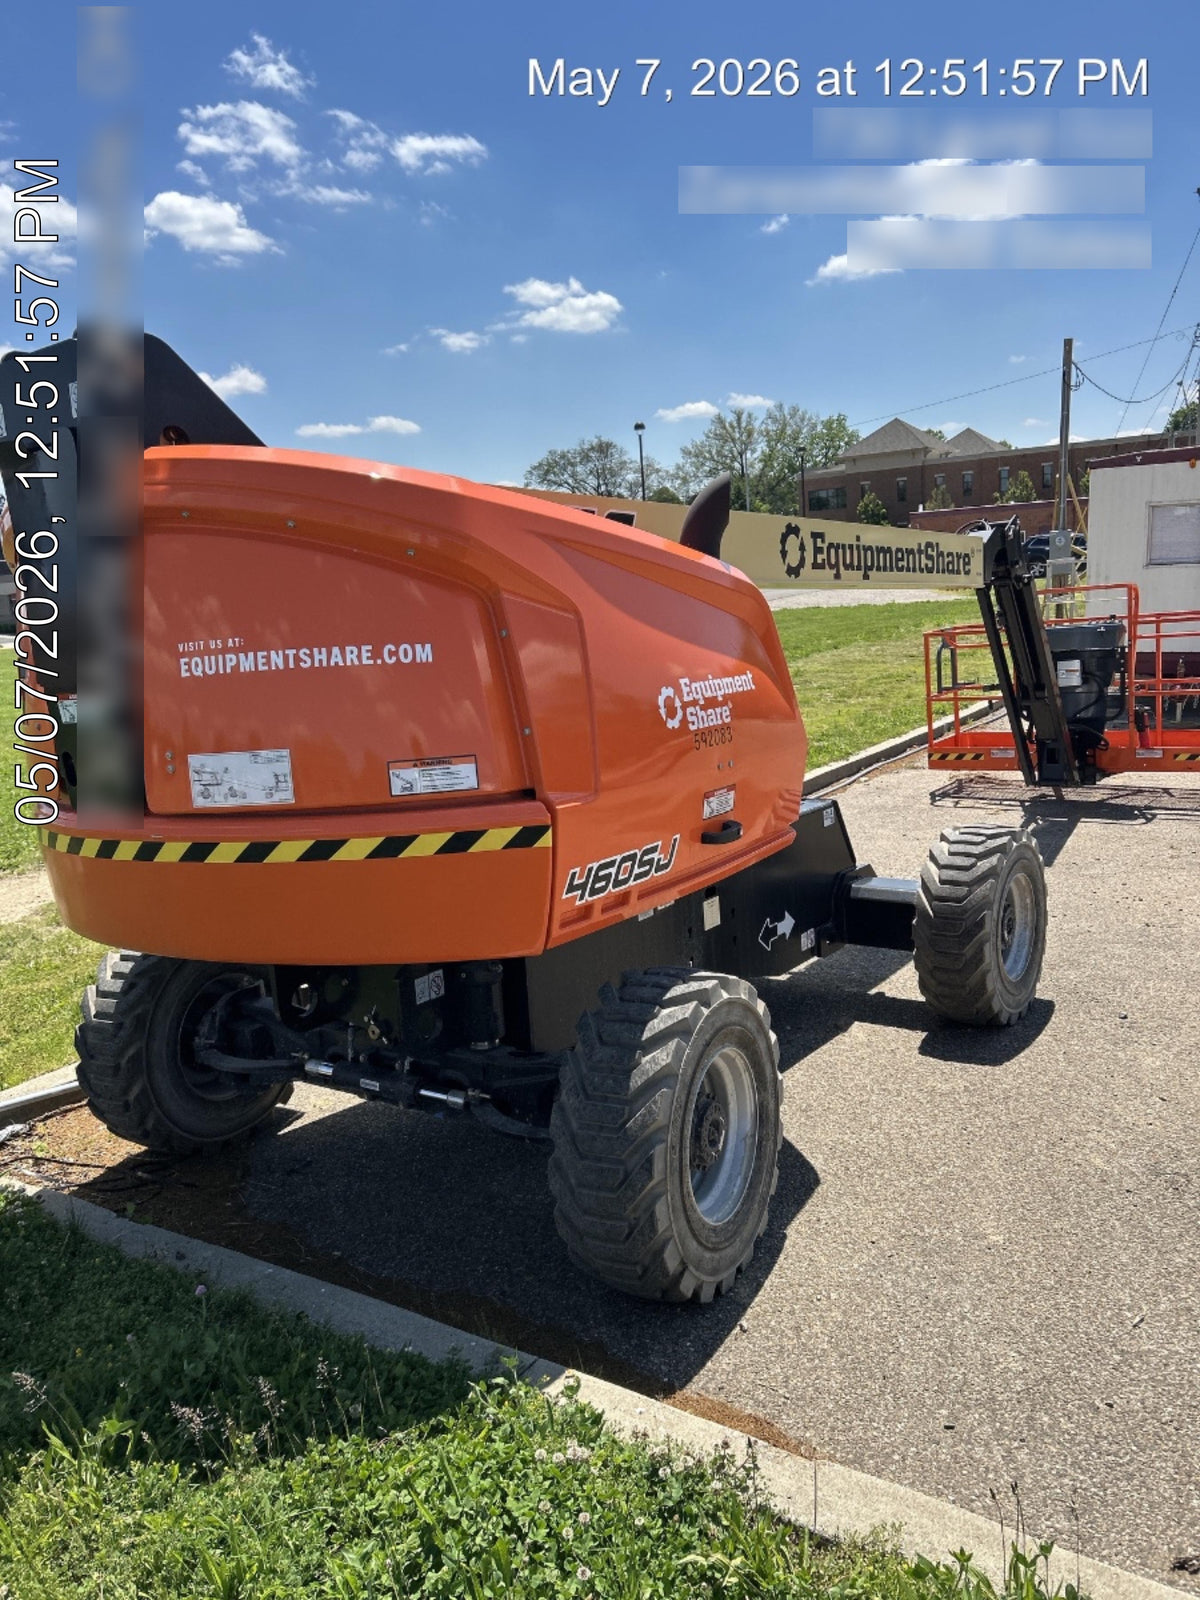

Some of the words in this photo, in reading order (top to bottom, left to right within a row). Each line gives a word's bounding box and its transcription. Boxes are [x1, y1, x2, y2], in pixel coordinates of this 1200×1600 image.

[811, 531, 972, 580] EquipmentShare
[178, 641, 205, 653] VISIT
[209, 640, 223, 649] US
[227, 638, 244, 648] AT:
[179, 643, 433, 678] EQUIPMENTSHARE.COM
[679, 670, 755, 702] Equipment
[686, 705, 732, 732] Share
[693, 727, 733, 751] 592083
[562, 833, 681, 906] 460SJ
